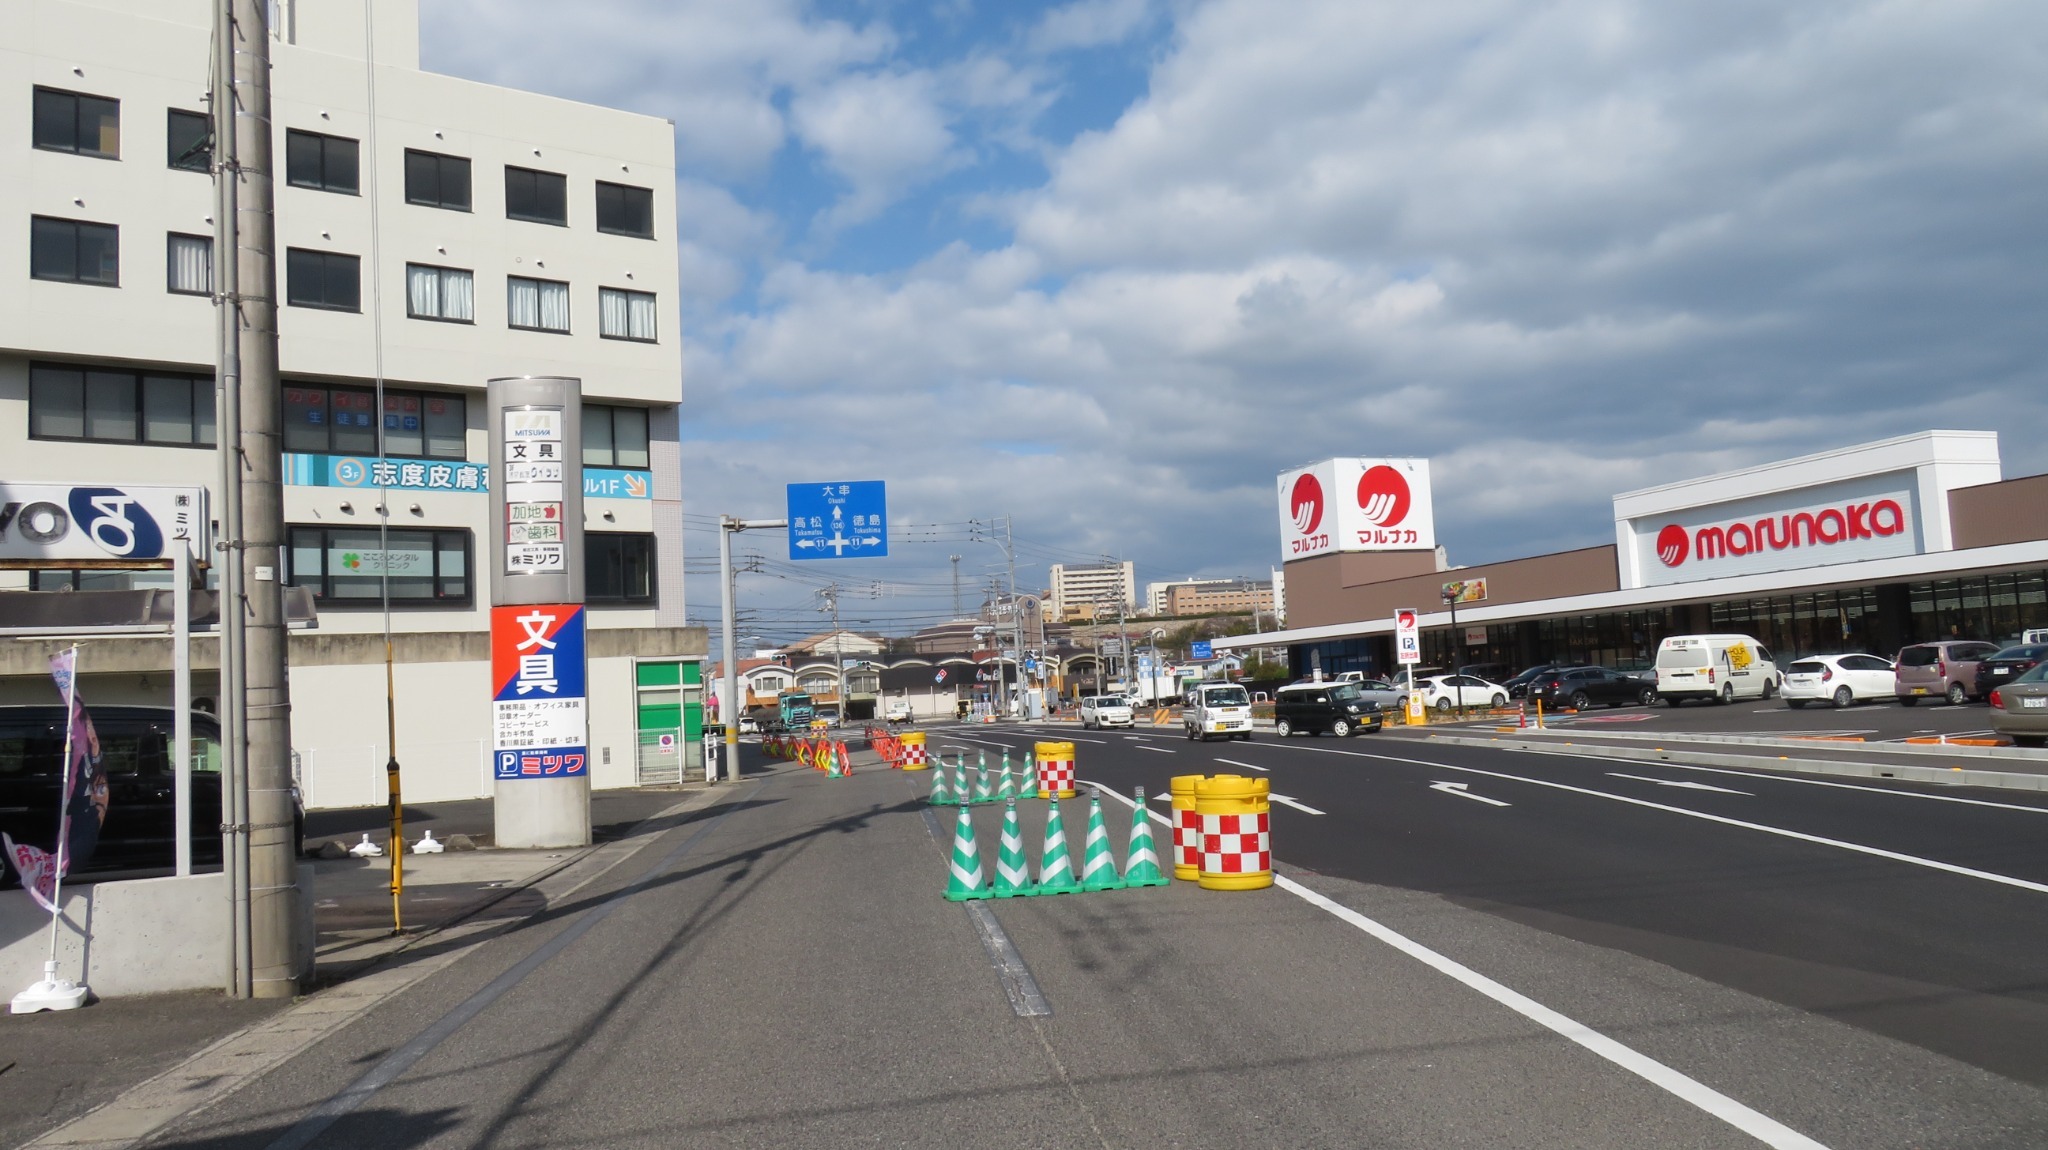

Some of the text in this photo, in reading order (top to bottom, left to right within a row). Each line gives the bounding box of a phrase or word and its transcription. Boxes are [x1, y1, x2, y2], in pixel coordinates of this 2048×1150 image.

[515, 429, 551, 437] MITSUWA
[513, 443, 554, 458] 文具
[822, 485, 850, 497] 大串
[512, 505, 541, 519] 加地
[794, 516, 822, 529] 高松
[853, 514, 881, 526] 徳島
[528, 525, 557, 539] 歯科
[1357, 529, 1417, 544] マルナカ
[1695, 499, 1905, 561] marunaka
[816, 539, 825, 548] 11
[851, 538, 860, 546] 11
[1292, 533, 1329, 553] マルナカ
[516, 610, 558, 695] 文具
[499, 720, 549, 728] コピーサービス
[502, 754, 515, 771] P
[521, 754, 584, 774] ミツワ
